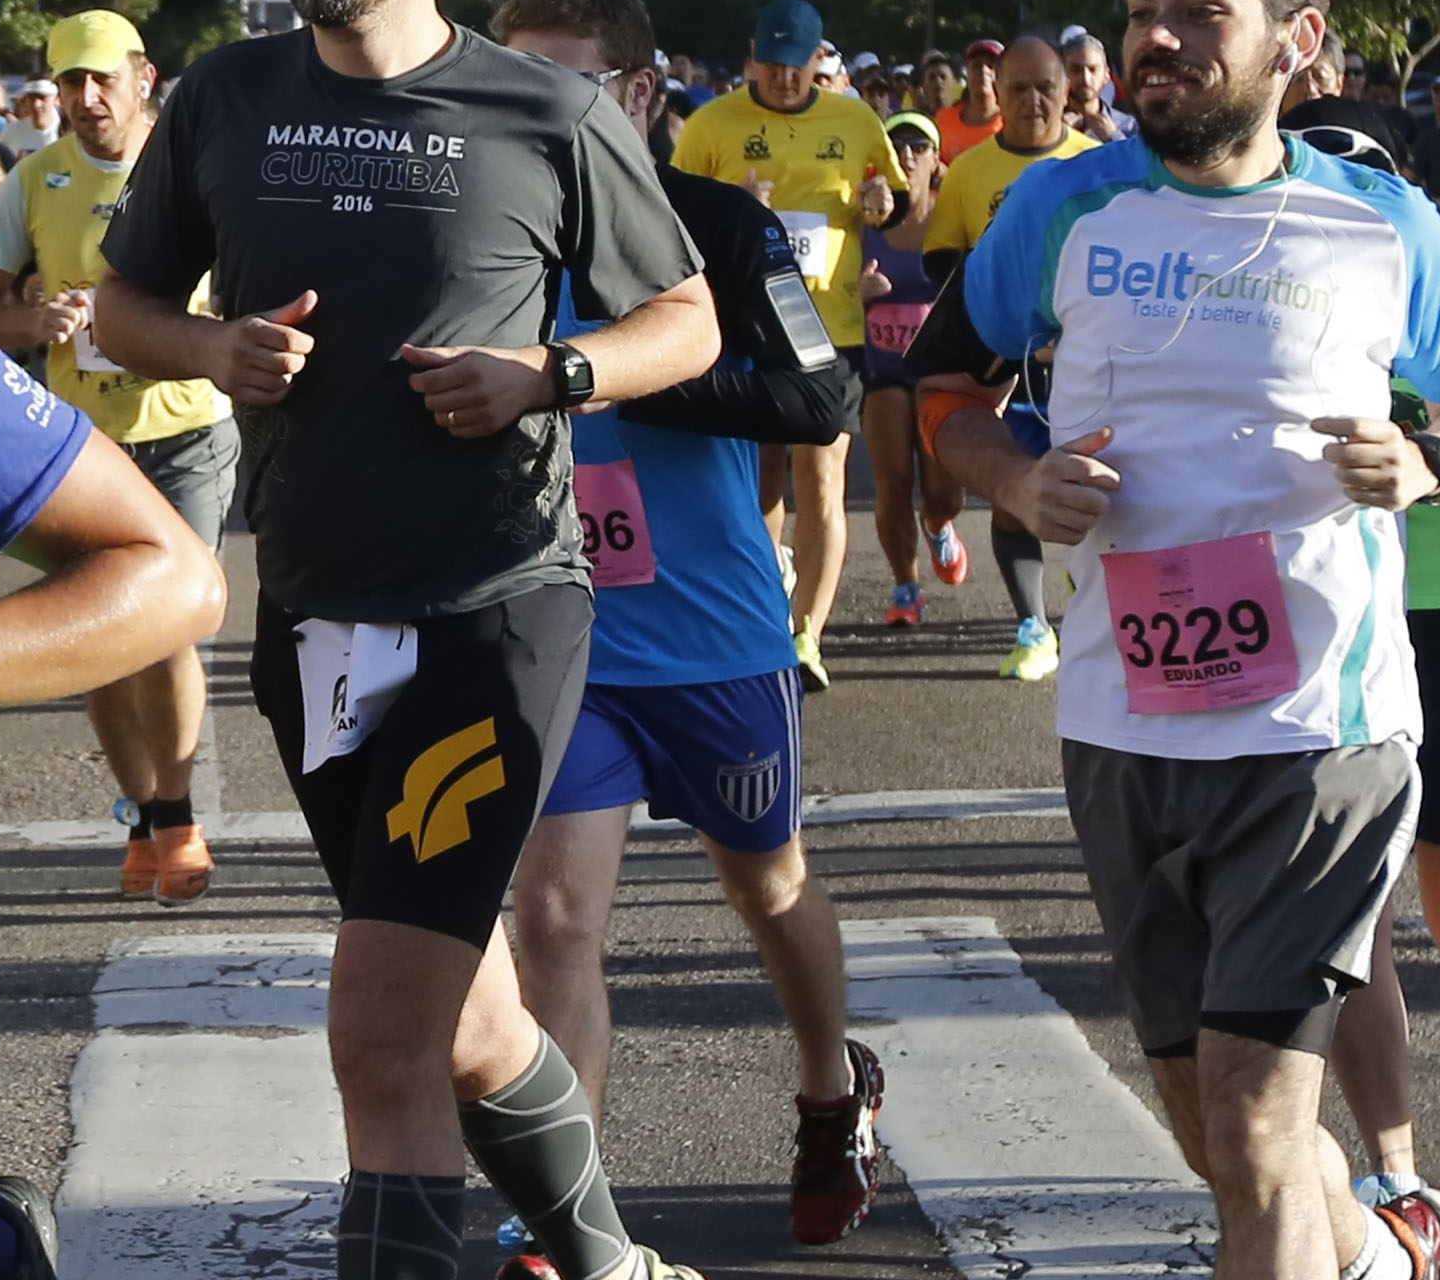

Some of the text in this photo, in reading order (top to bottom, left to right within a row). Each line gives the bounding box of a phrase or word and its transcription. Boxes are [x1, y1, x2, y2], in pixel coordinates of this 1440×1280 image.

[267, 125, 465, 159] MARATONA DE
[260, 151, 460, 196] CURITIBA
[332, 194, 373, 212] 2016
[1131, 299, 1177, 319] Taste
[1201, 305, 1252, 326] better
[1120, 599, 1269, 669] 3229
[1164, 661, 1242, 683] EDUARDO
